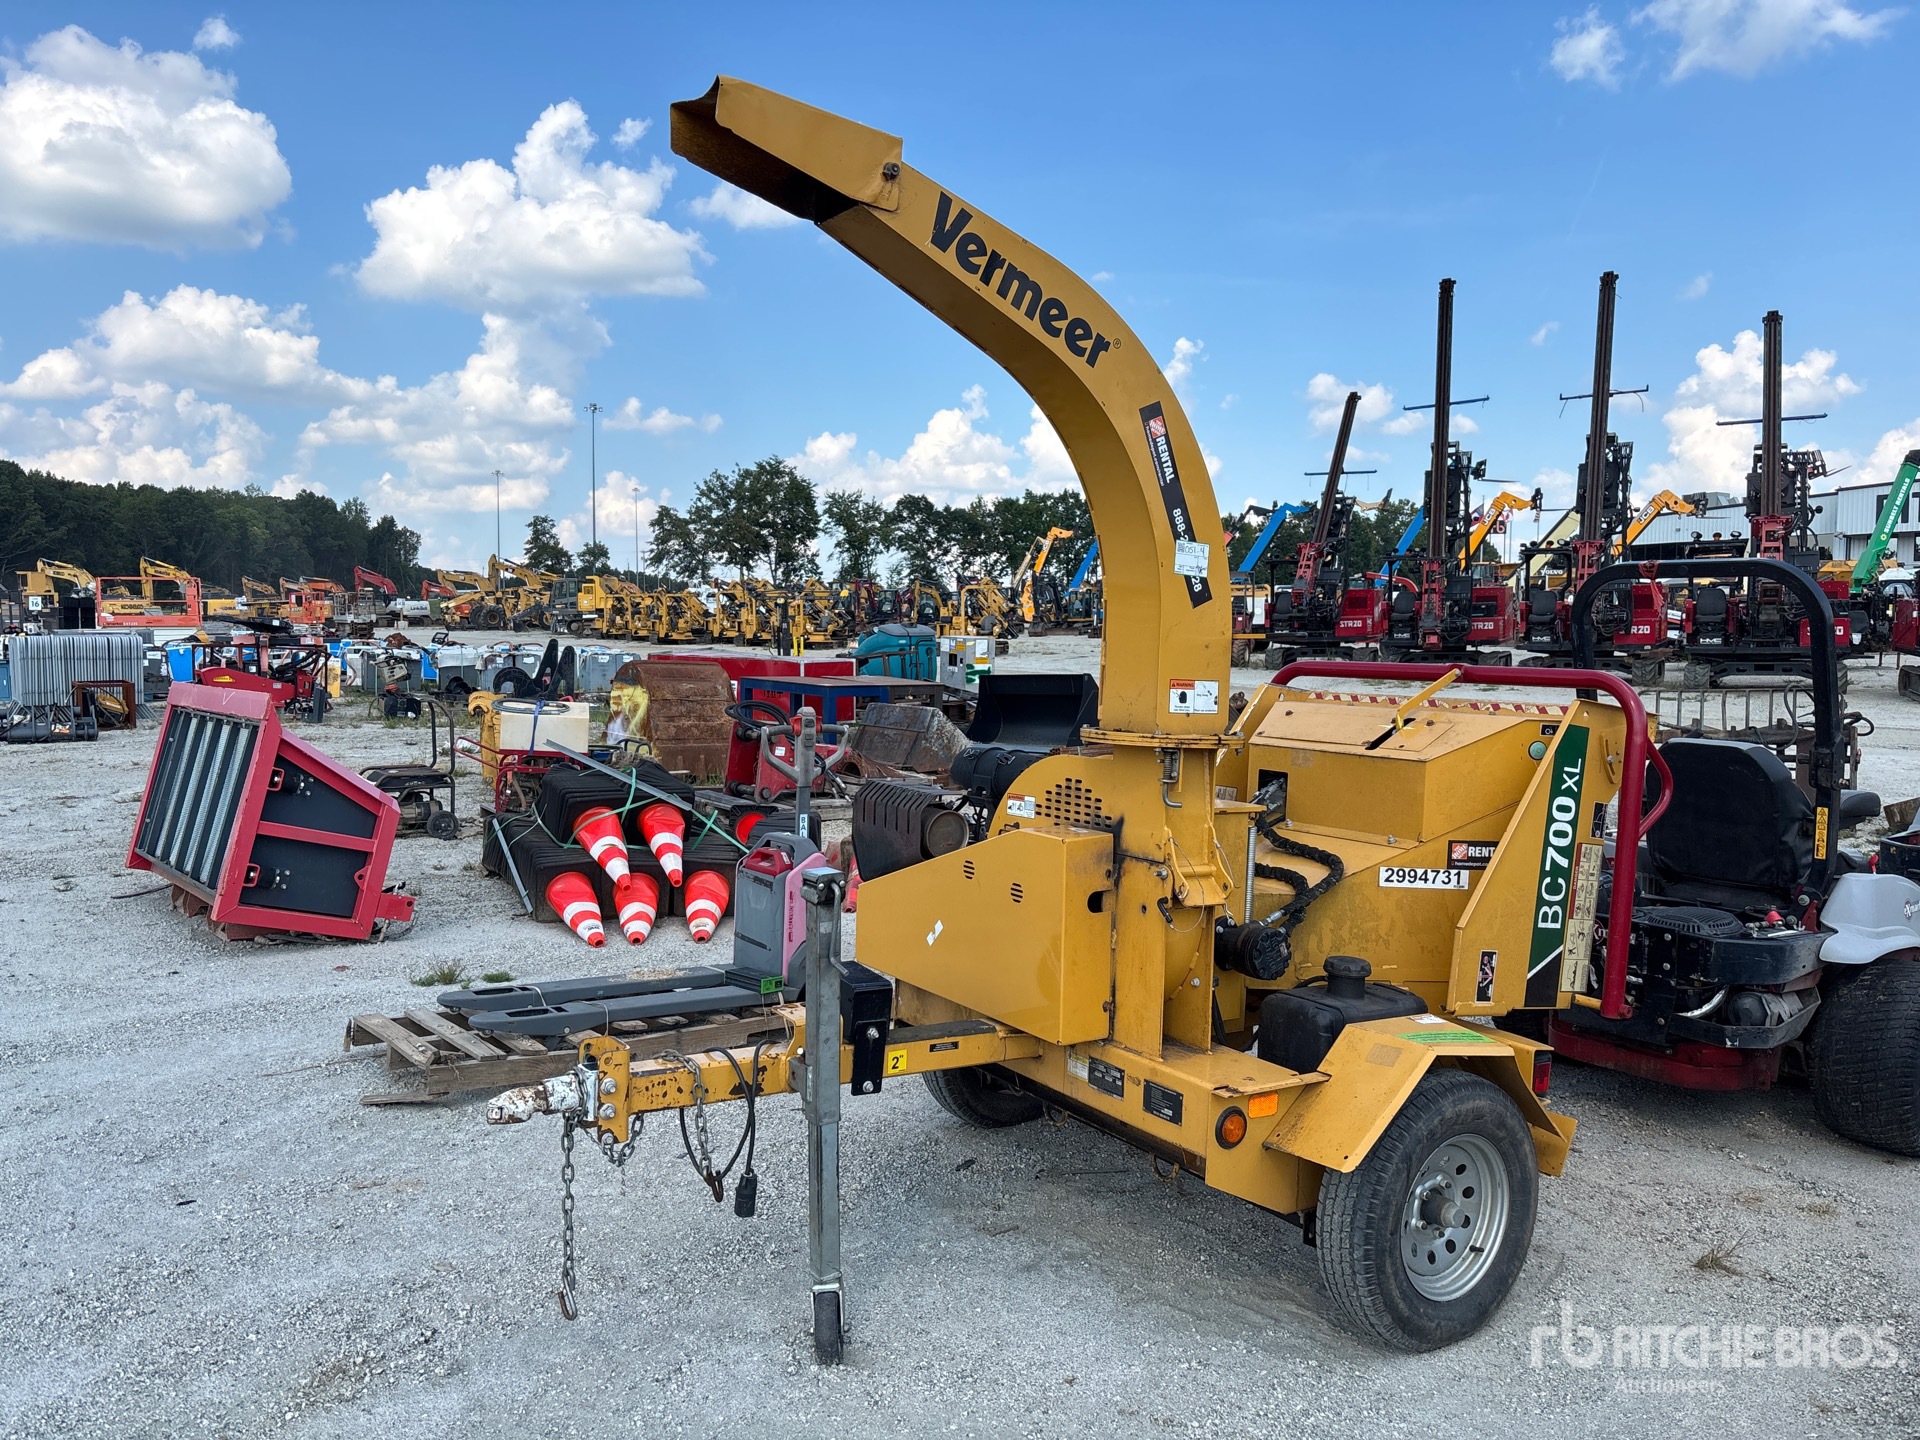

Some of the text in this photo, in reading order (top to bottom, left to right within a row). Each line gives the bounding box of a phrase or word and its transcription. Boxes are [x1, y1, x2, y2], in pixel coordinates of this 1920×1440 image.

[930, 191, 1112, 368] Vermeer
[1156, 436, 1175, 483] RENTAL
[1483, 508, 1496, 526] JCB
[1639, 505, 1655, 524] JCB
[1540, 568, 1563, 576] VOLVO
[31, 600, 40, 608] 16
[1339, 620, 1362, 628] STR20
[1561, 758, 1582, 792] XL
[1468, 846, 1496, 858] RENT
[1384, 868, 1461, 885] 2994731
[891, 1055, 904, 1070] 2"
